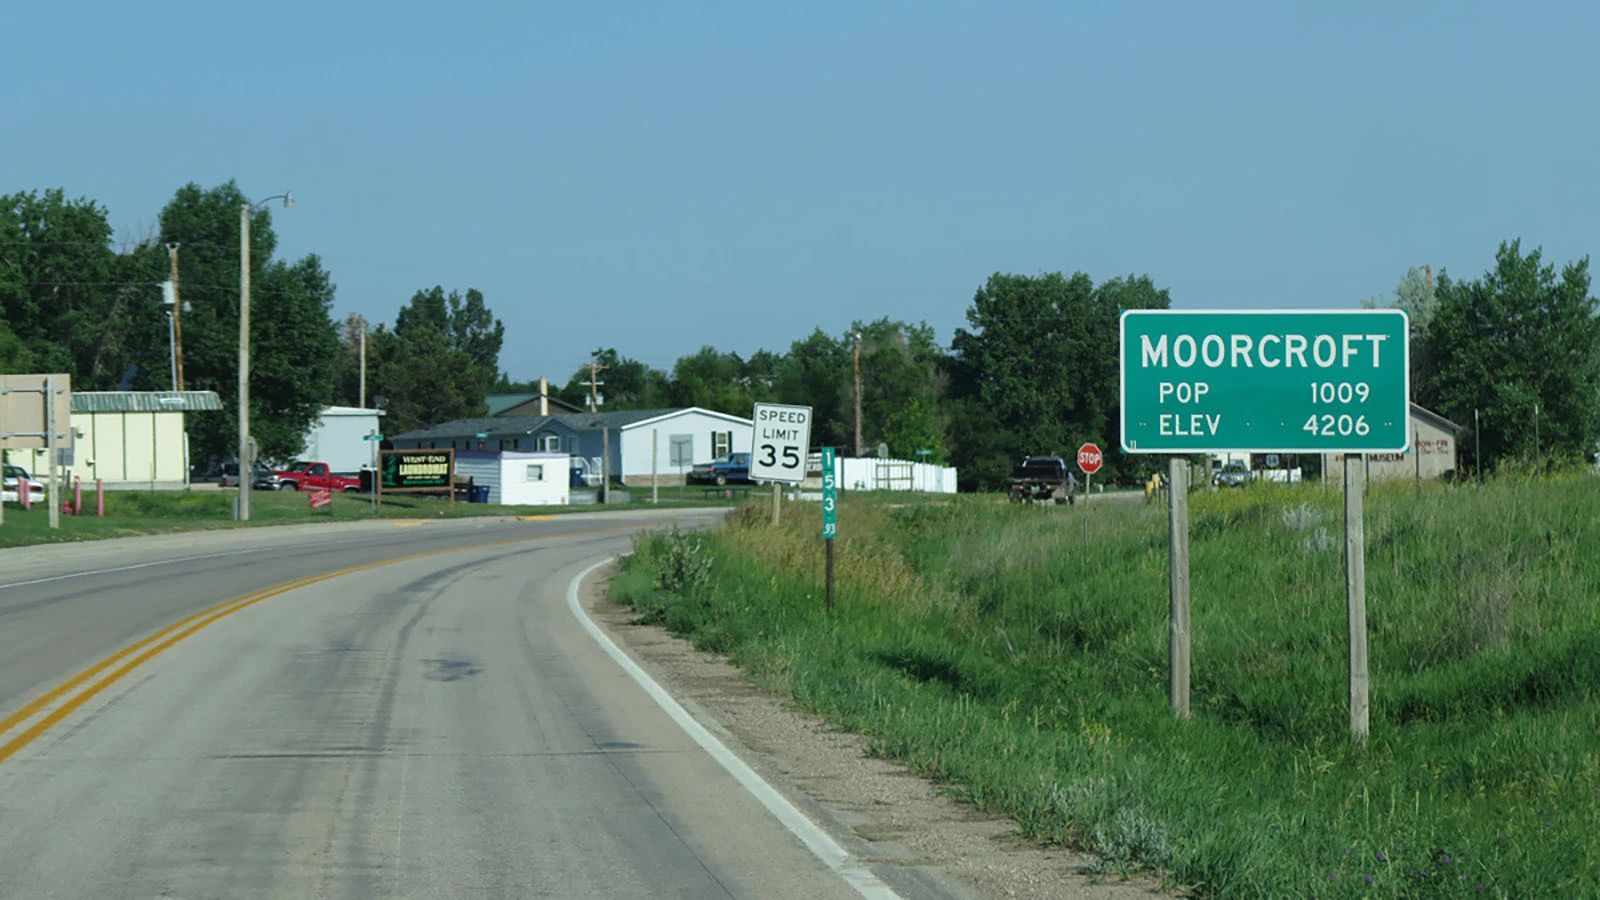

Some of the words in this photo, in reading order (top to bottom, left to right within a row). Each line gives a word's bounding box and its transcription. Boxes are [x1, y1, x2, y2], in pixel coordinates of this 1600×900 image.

[1141, 334, 1387, 368] MOORCROFT
[1159, 382, 1209, 404] POP
[1311, 382, 1370, 404] 1009
[759, 409, 806, 424] SPEED
[1159, 414, 1221, 436] ELEV
[1303, 414, 1370, 436] 4206
[762, 427, 799, 441] LIMIT
[758, 444, 799, 469] 35
[1080, 452, 1100, 465] STOP
[1369, 452, 1404, 462] MUSEUM
